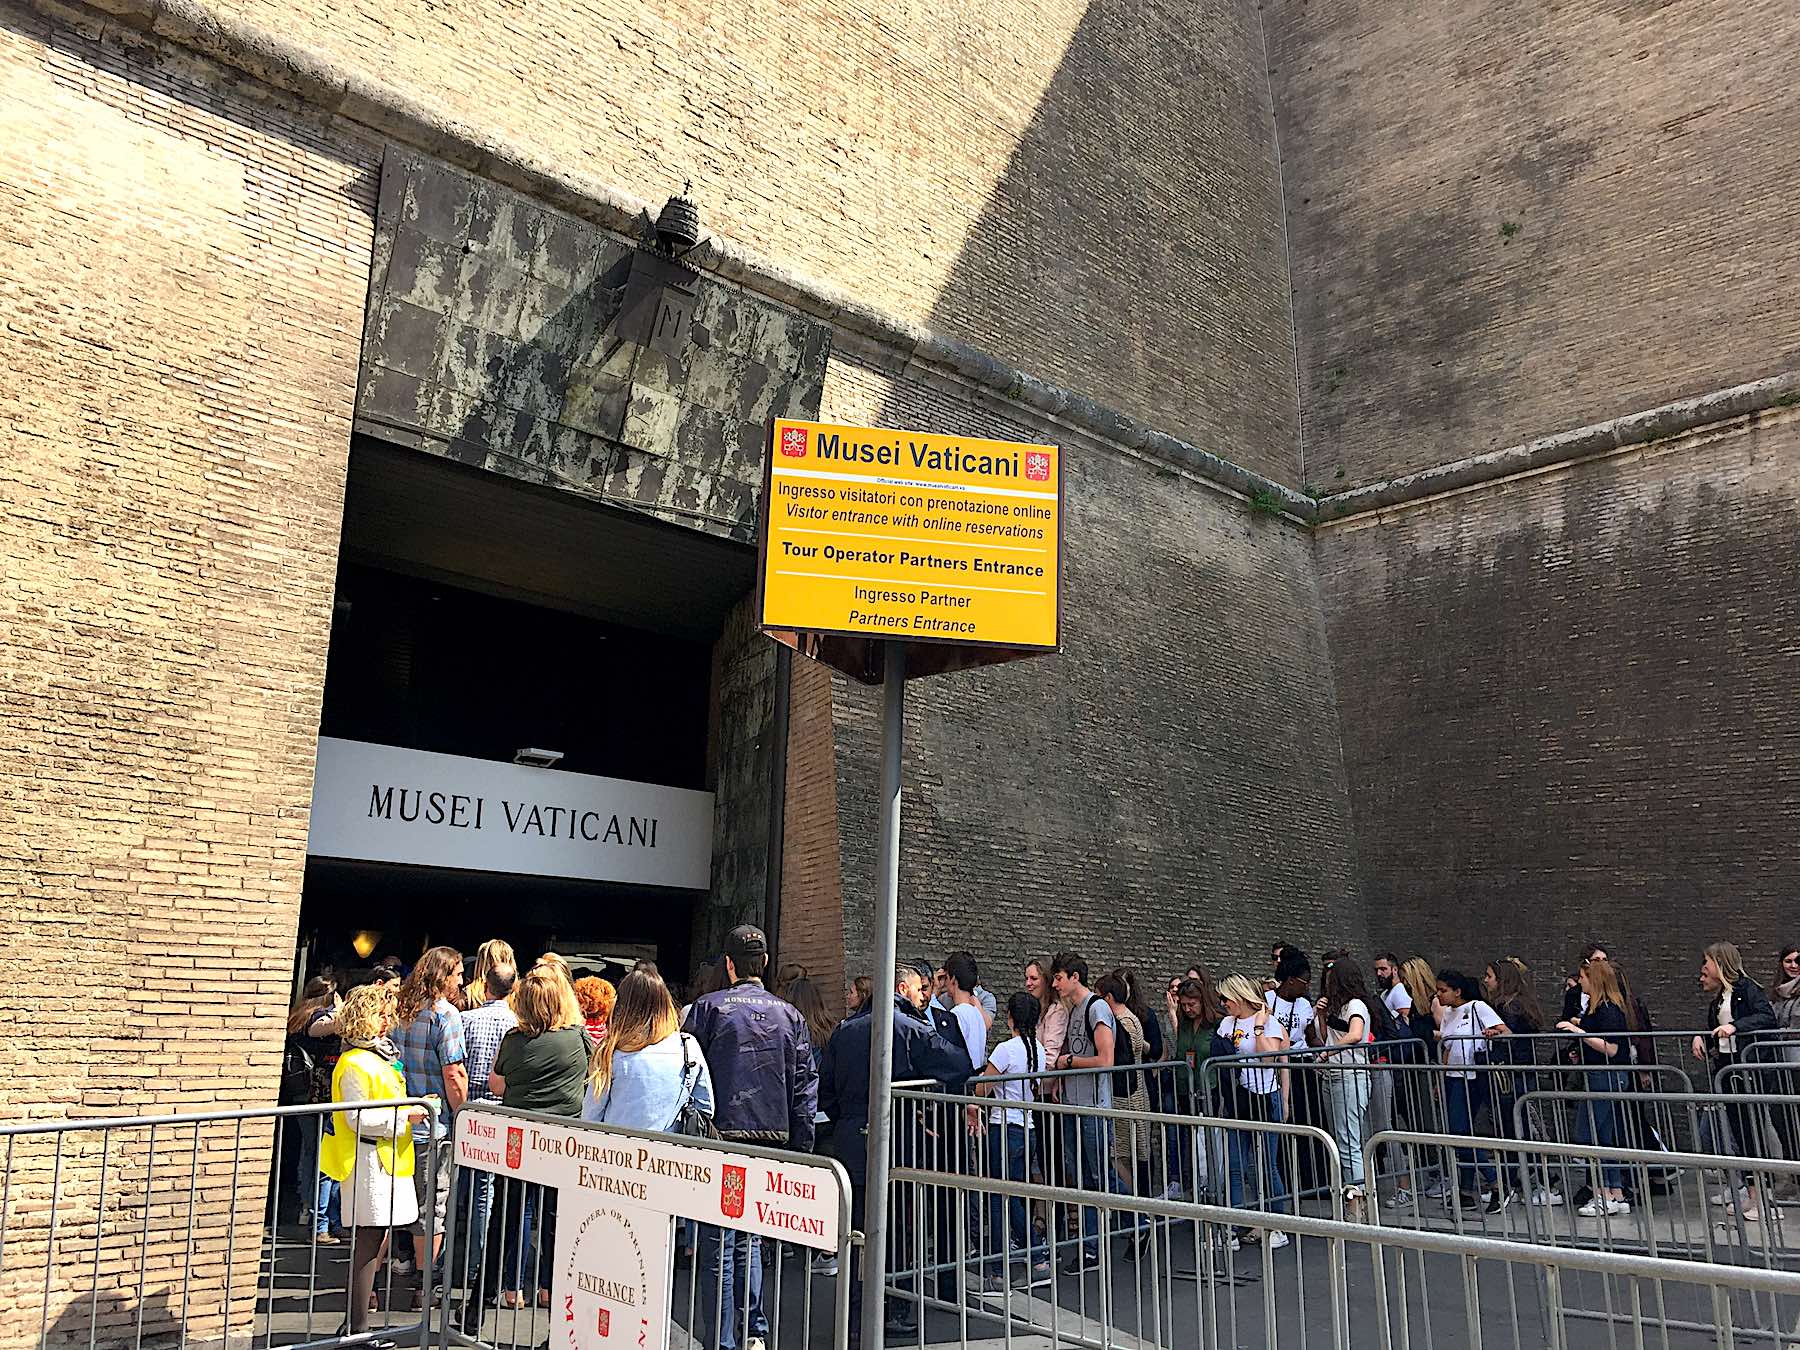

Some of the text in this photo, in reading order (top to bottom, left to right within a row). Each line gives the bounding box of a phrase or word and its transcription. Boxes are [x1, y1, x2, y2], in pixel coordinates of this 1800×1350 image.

[817, 433, 1018, 477] Musei Vaticani
[779, 481, 1051, 520] Ingresso visitatori con prenotazione online
[787, 503, 1044, 539] Visitor entrance with online reservations
[782, 541, 1044, 577] Tour Operator Partners Entrance
[855, 585, 972, 608] Ingresso Partner
[848, 610, 976, 633] Partners Entrance
[368, 785, 658, 848] MUSEI VATICANI
[467, 1119, 496, 1139] MUSEI
[460, 1141, 500, 1165] VATICANI
[529, 1128, 712, 1184] TOUR OPERATOR PARTNERS
[577, 1165, 647, 1200] ENTRANCE
[766, 1170, 816, 1200] MUSEI
[755, 1201, 825, 1236] VATICANI
[577, 1271, 635, 1305] ENTRANCE
